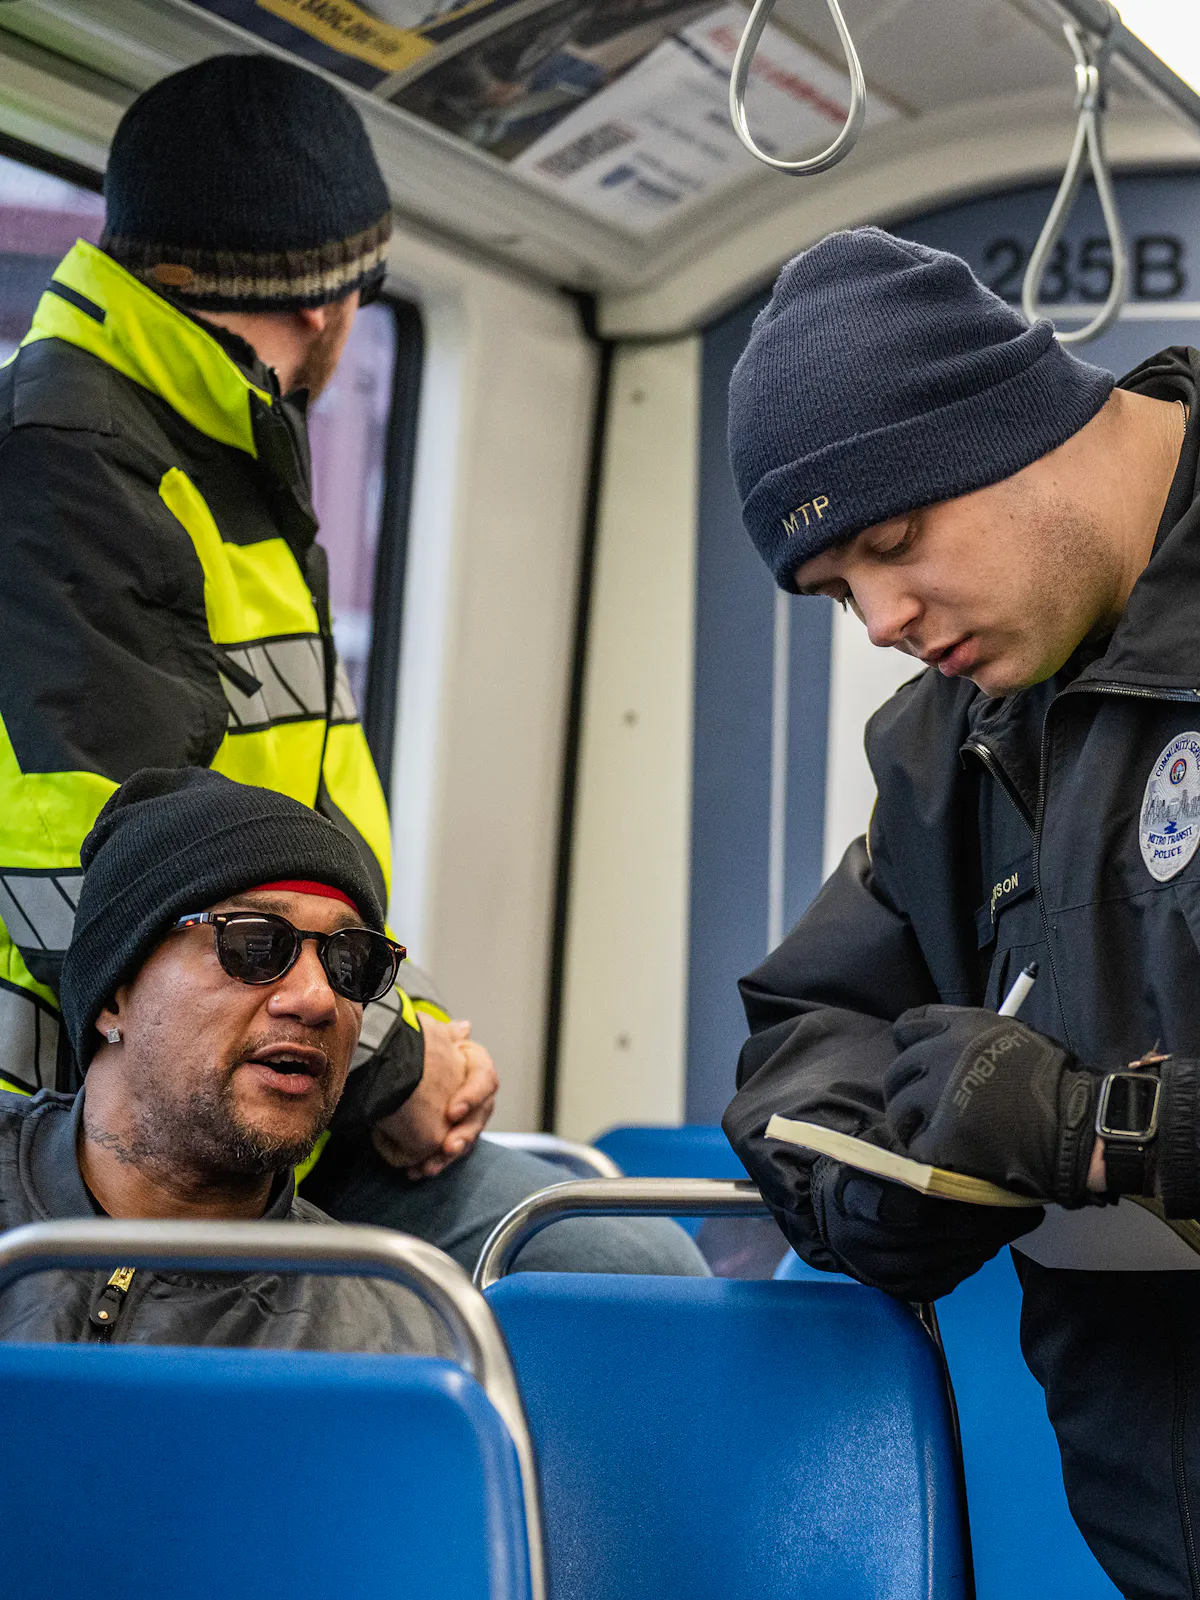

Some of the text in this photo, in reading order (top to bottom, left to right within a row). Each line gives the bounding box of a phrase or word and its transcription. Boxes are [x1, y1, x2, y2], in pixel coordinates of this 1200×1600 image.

[781, 495, 829, 539] MTP
[1156, 740, 1190, 777] COMMUNITY
[1167, 826, 1193, 846] TRANSIT
[1153, 846, 1182, 859] POLICE
